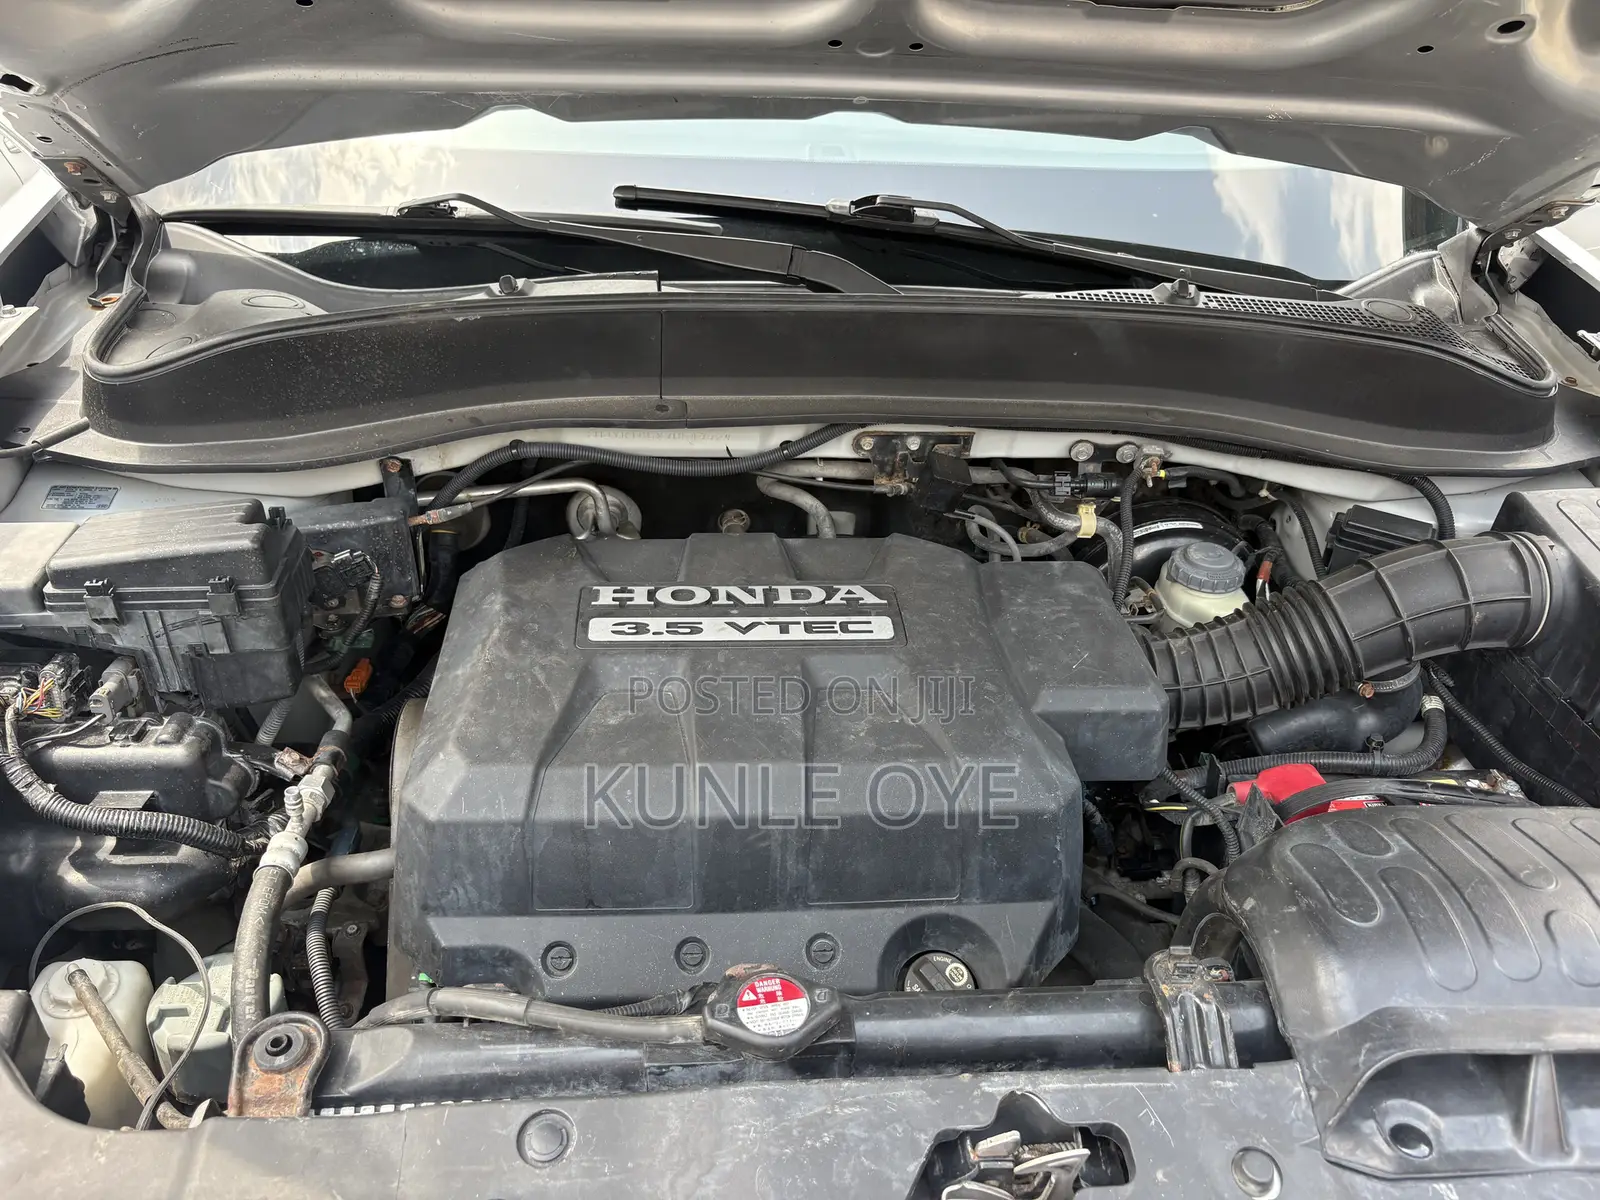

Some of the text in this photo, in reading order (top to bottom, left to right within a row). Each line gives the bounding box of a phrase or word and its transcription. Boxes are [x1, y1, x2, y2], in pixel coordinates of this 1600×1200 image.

[589, 585, 889, 607] HONDA
[610, 620, 874, 636] 3.5 VTEC
[754, 979, 780, 988] DANGER
